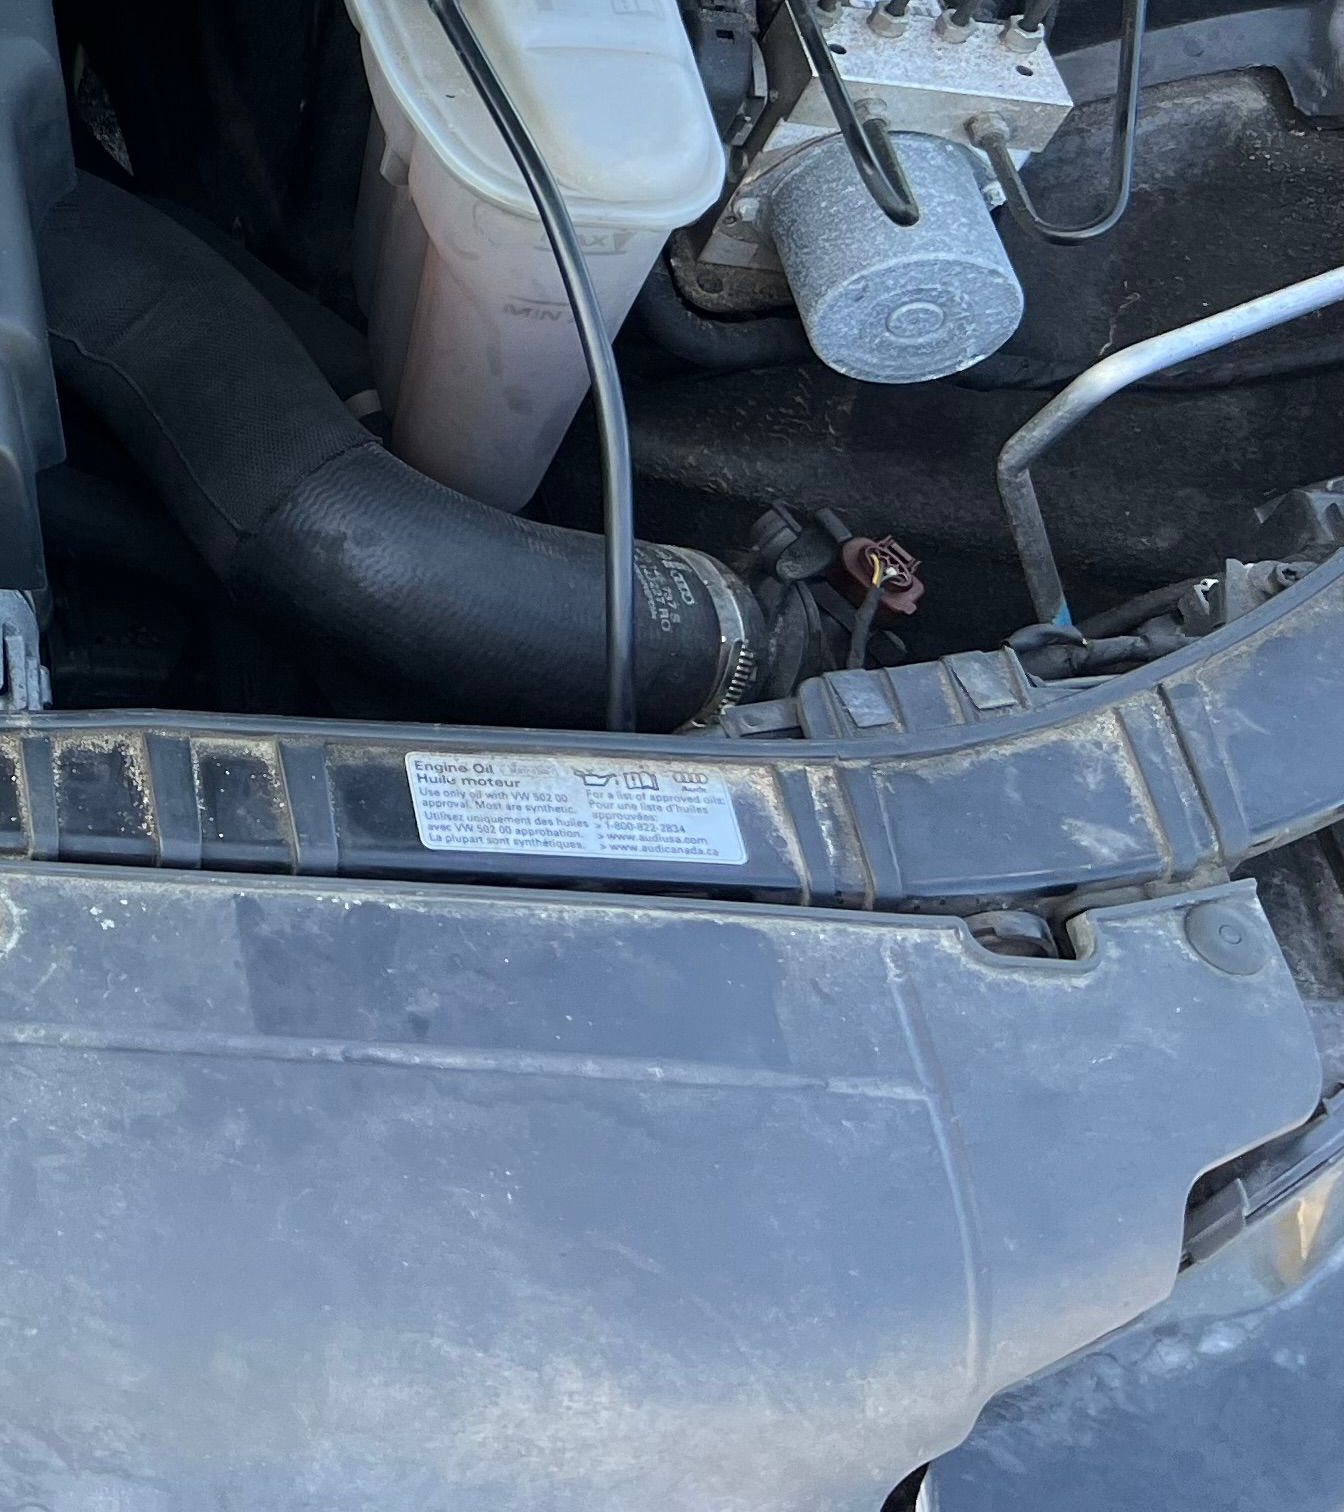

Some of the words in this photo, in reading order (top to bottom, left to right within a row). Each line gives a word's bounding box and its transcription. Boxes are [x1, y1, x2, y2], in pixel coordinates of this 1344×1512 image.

[415, 760, 467, 774] Engine
[473, 764, 493, 774] Oil
[462, 777, 520, 787] moteur
[420, 788, 441, 797] Use
[443, 789, 466, 800] only
[485, 792, 508, 800] with
[511, 792, 529, 800] VW
[534, 793, 553, 802] 502
[556, 795, 568, 803] 00
[586, 790, 604, 799] For
[617, 791, 633, 800] list
[636, 793, 646, 801] of
[650, 794, 701, 803] approved
[475, 801, 502, 810] Most
[589, 800, 614, 809] Pour
[641, 802, 662, 812] liste
[424, 811, 463, 821] Utilisez
[467, 814, 531, 826] uniquement
[535, 817, 553, 826] des
[557, 818, 589, 828] huiles
[455, 824, 474, 832] VW
[477, 825, 496, 834] 502
[446, 834, 483, 845] plupart
[487, 837, 509, 845] sont
